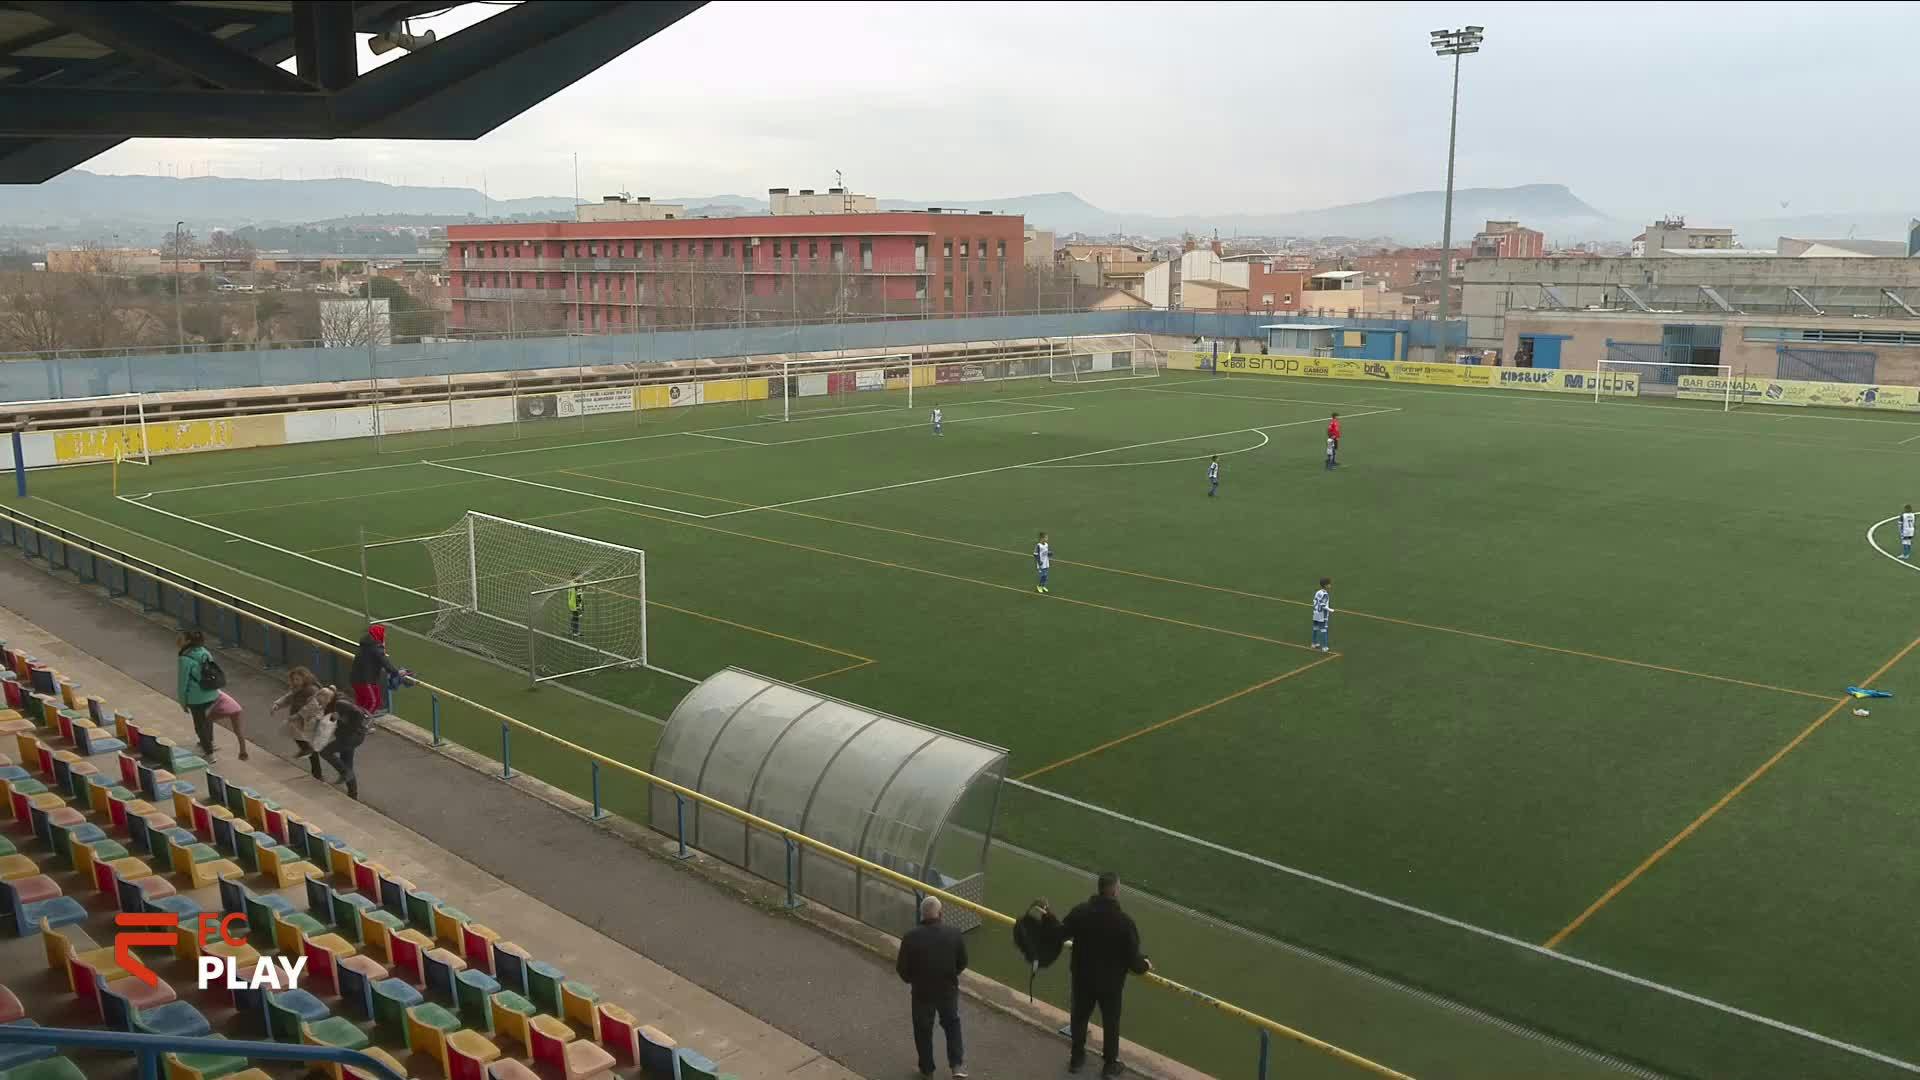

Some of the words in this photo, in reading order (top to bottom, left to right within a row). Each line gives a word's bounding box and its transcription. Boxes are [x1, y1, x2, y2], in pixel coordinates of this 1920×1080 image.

[1249, 358, 1299, 374] snop
[1364, 361, 1386, 374] brillo
[1500, 371, 1548, 383] KIDS&US
[1683, 378, 1703, 388] BAR
[1706, 380, 1758, 390] GRANADA
